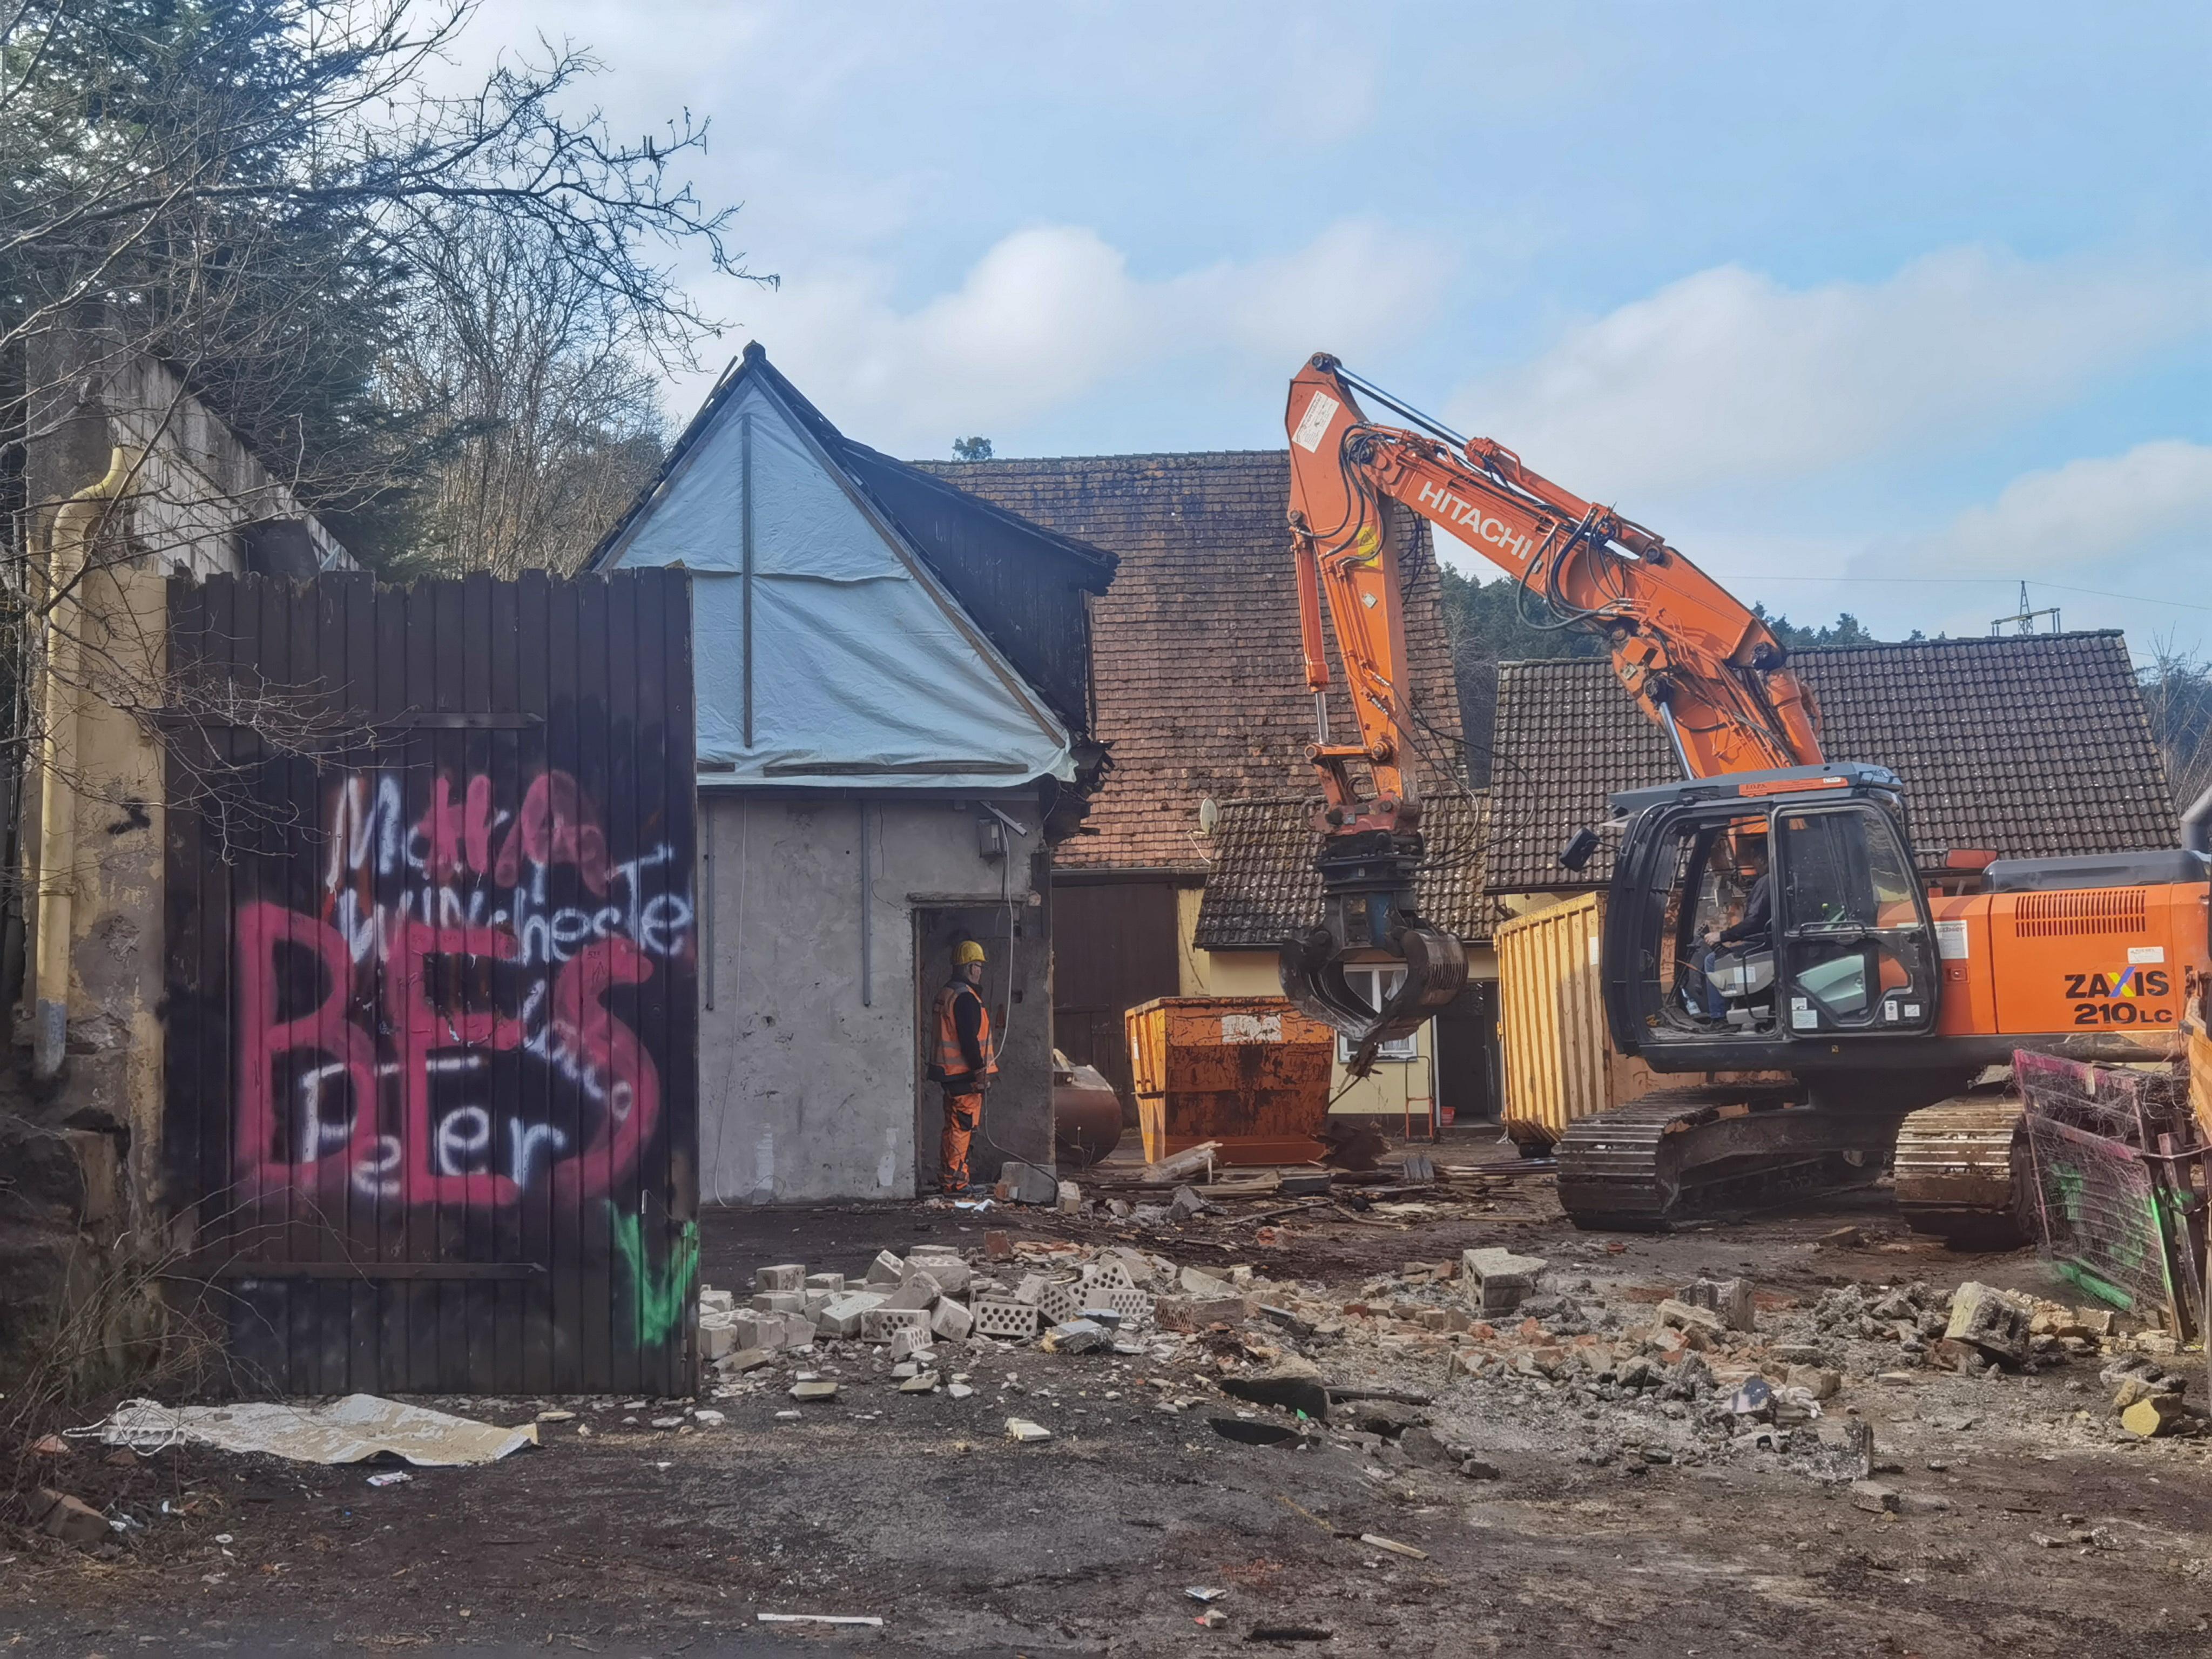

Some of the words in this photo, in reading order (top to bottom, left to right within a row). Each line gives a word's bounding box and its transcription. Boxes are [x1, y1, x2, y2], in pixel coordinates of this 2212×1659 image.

[1418, 481, 1533, 560] HITACHI
[2065, 966, 2169, 999] ZAXIS
[236, 899, 660, 1204] BES
